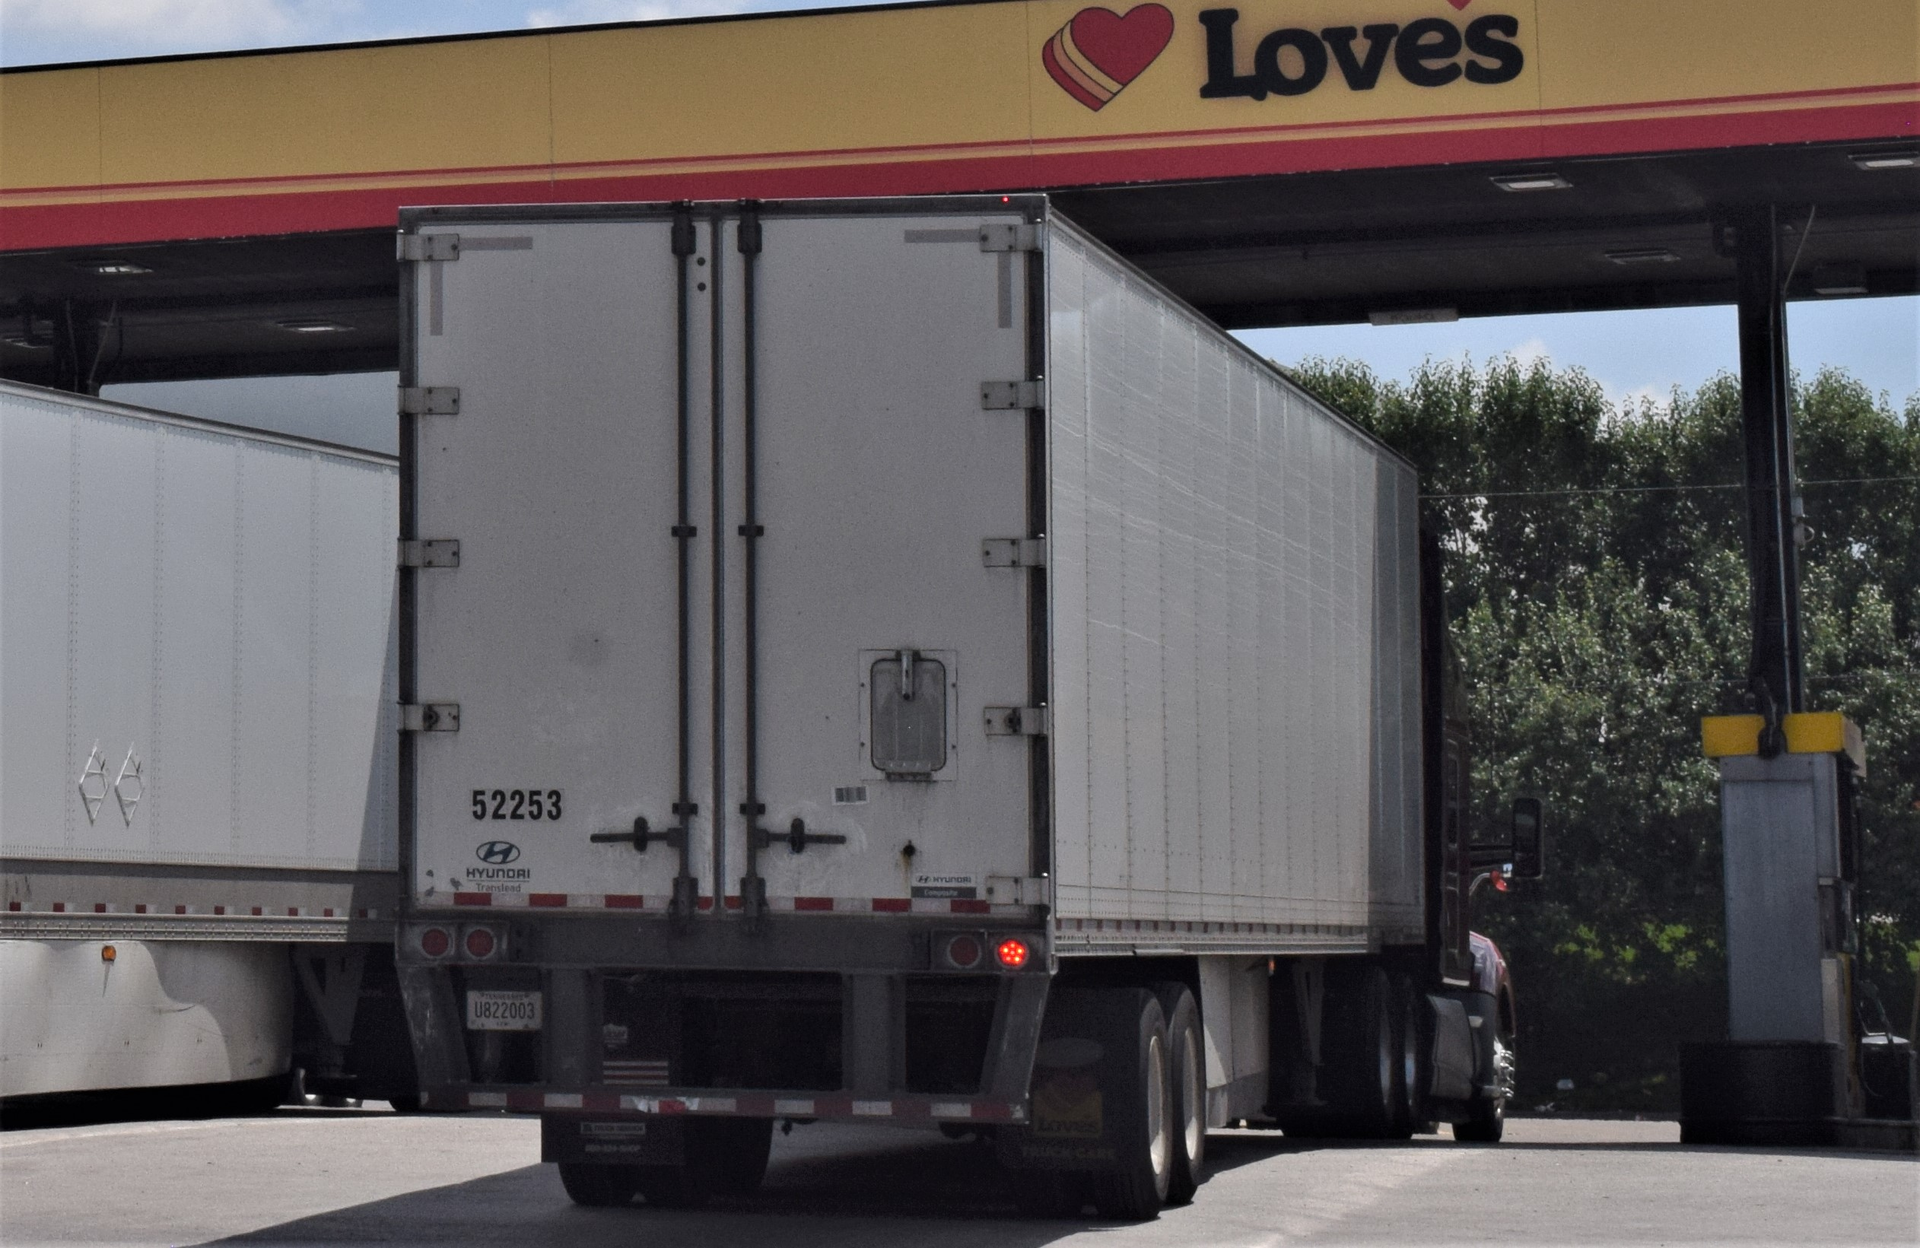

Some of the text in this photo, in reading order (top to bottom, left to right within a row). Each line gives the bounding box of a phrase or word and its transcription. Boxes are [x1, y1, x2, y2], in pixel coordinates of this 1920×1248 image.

[471, 788, 563, 821] 52253
[465, 867, 531, 880] HYUNDAI
[933, 875, 972, 884] HYUNDAI
[475, 882, 522, 893] Translead
[474, 1001, 535, 1020] U822003
